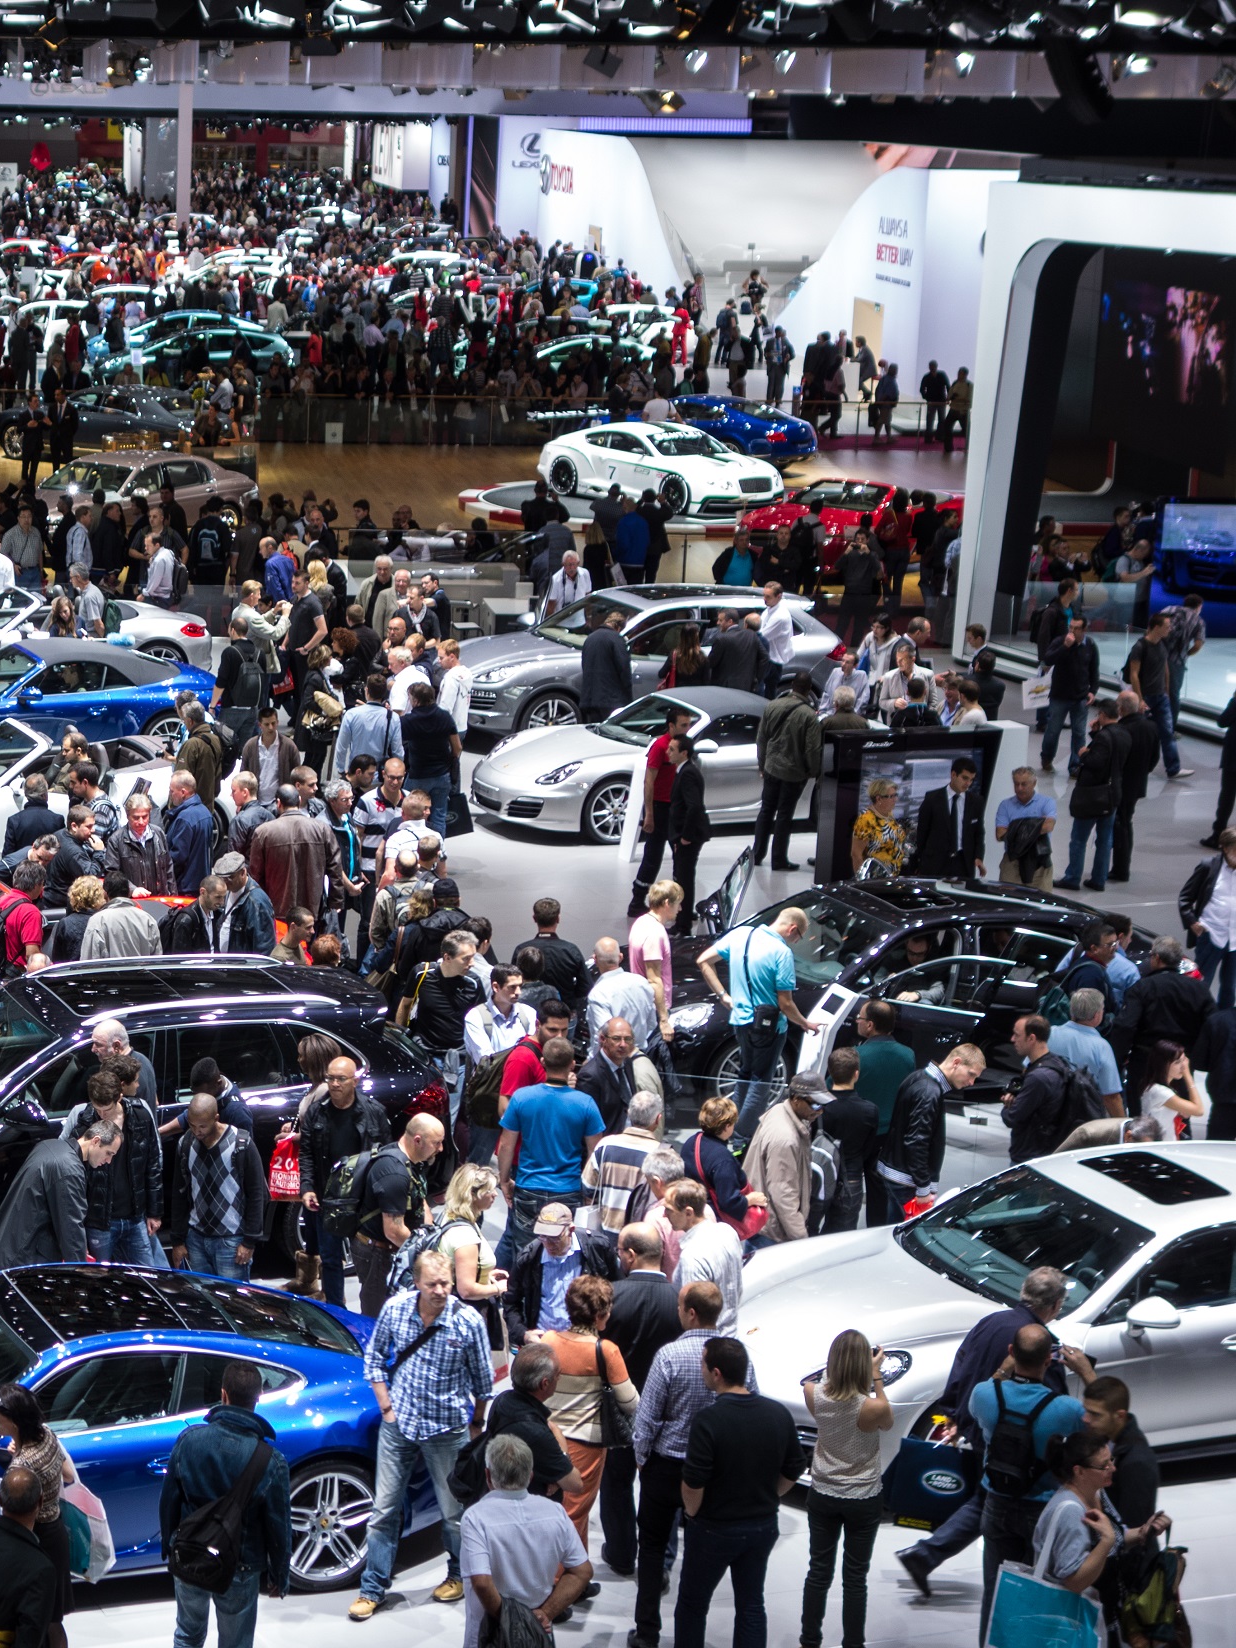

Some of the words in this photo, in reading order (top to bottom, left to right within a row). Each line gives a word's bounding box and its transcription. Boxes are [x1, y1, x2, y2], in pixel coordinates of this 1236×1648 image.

[511, 160, 542, 169] LEX
[551, 163, 574, 194] TOYOTA
[878, 216, 903, 238] ALWAYS
[876, 243, 899, 265] BETTER
[899, 246, 914, 267] WAY
[608, 465, 617, 480] 7
[272, 1156, 299, 1171] 20
[270, 1178, 301, 1190] L'AUTOMO
[931, 1475, 953, 1483] LAND
[932, 1481, 958, 1490] ROVER
